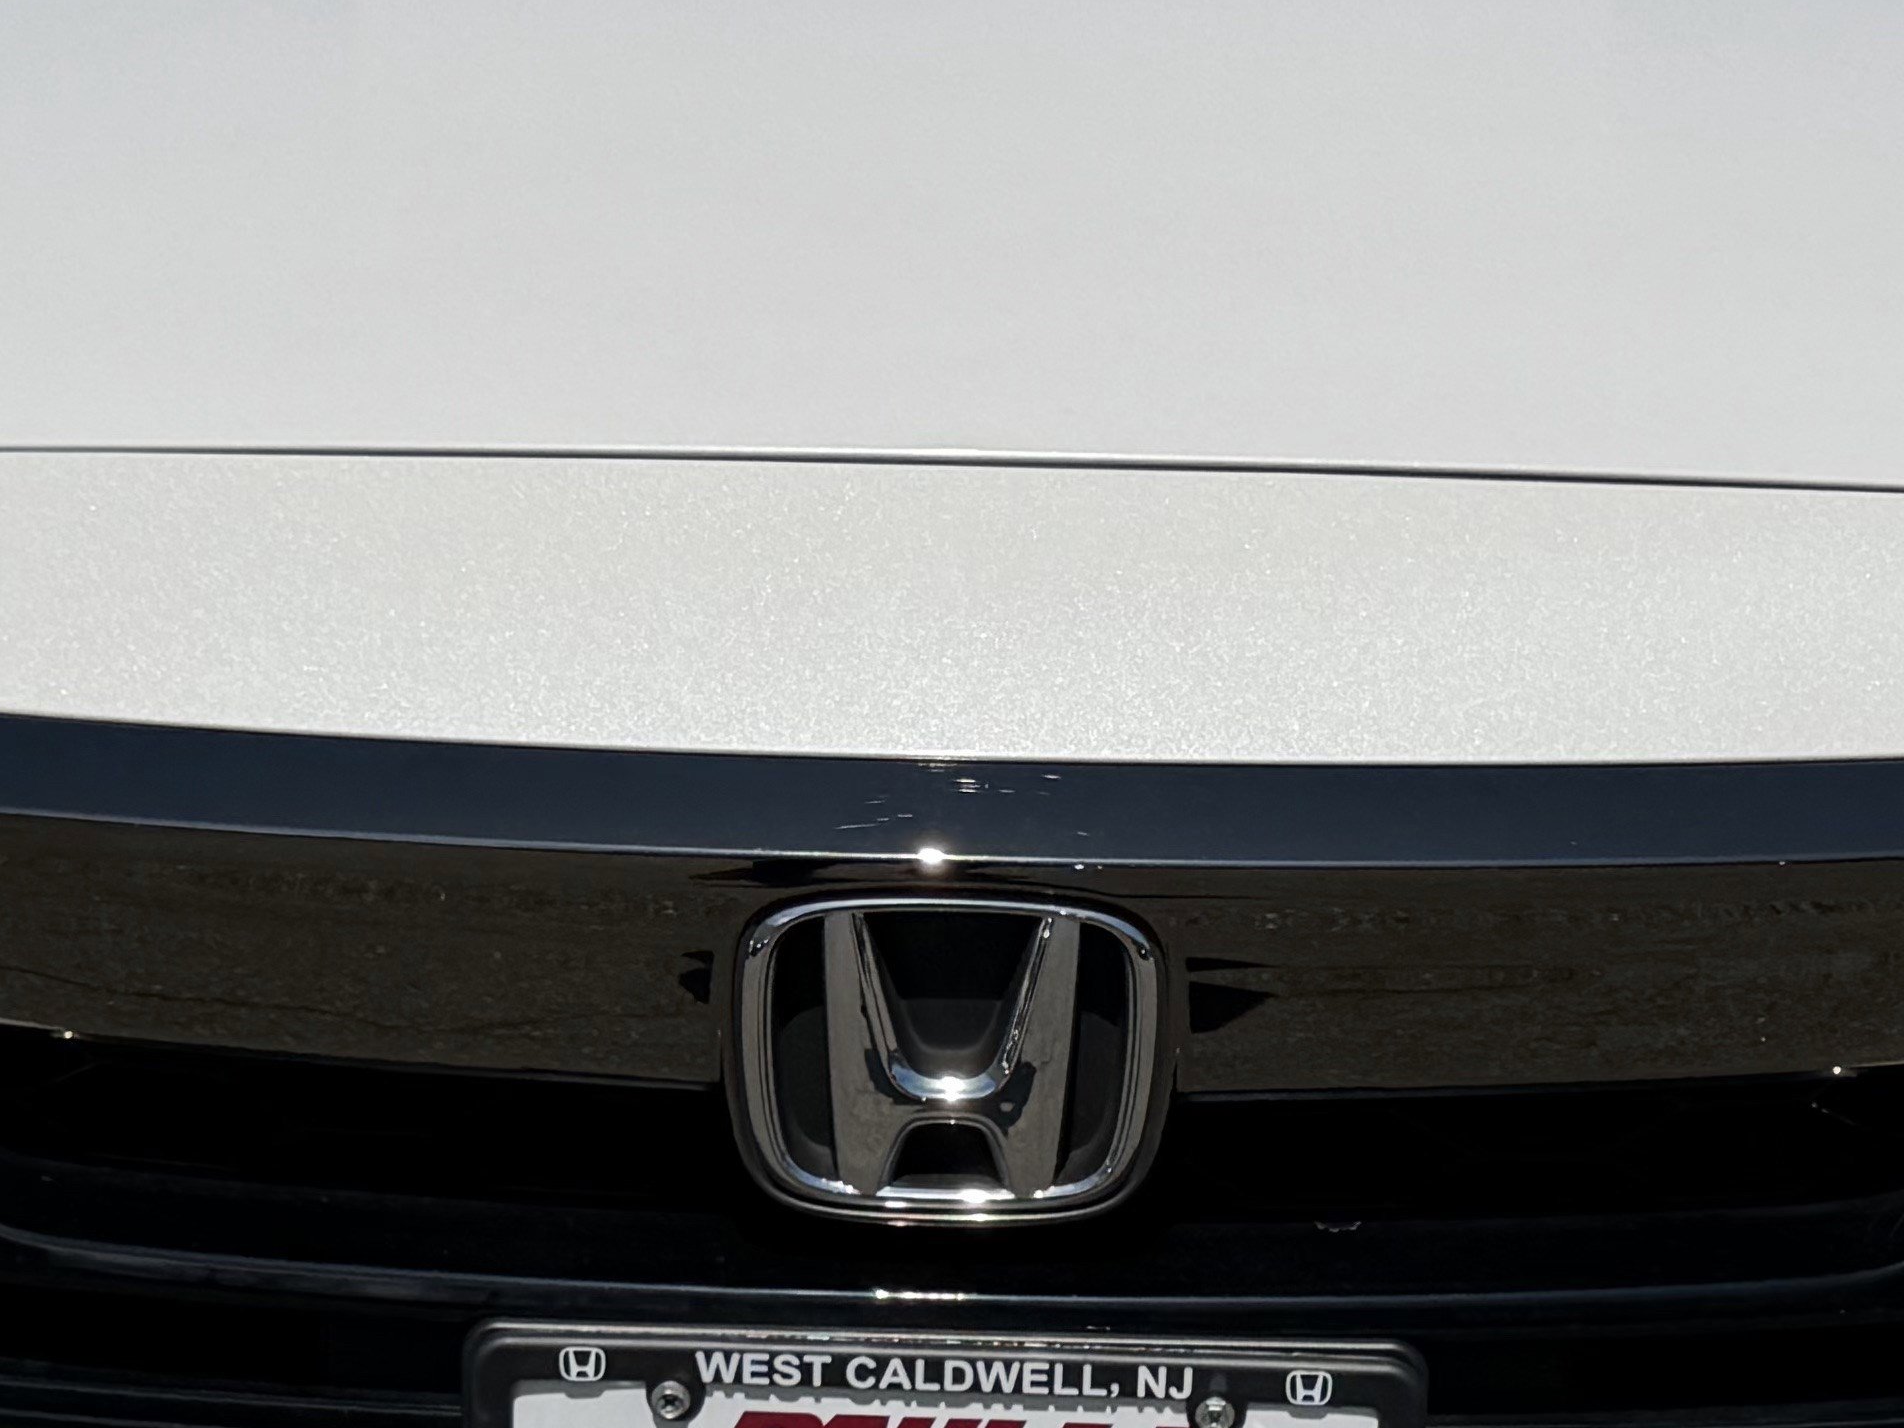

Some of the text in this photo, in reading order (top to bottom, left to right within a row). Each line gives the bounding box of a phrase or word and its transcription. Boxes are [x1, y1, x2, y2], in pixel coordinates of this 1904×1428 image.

[696, 1350, 1193, 1400] WEST CALDWELL, NJ
